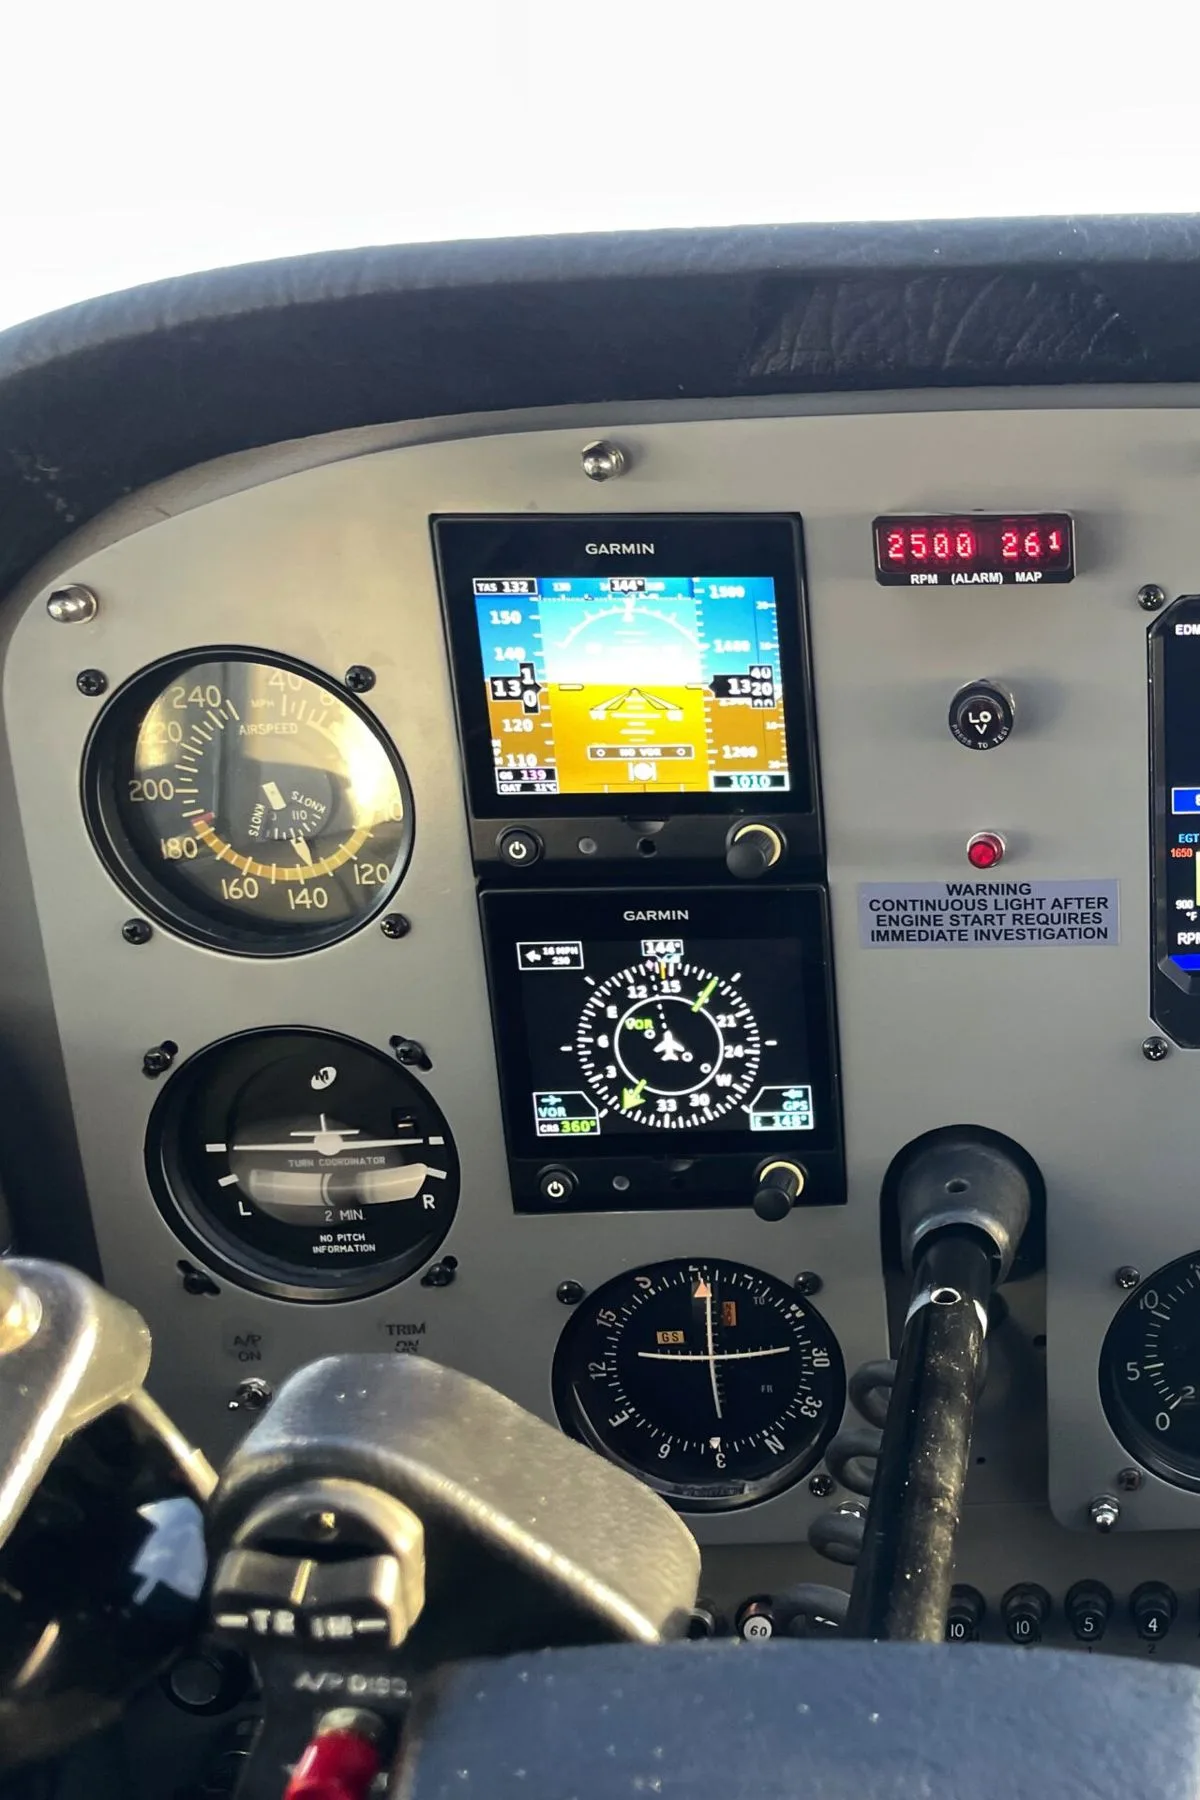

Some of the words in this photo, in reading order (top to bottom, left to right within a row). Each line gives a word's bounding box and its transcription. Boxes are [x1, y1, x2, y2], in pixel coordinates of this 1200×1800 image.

[585, 543, 654, 555] GARMIN
[888, 533, 974, 559] 2500
[911, 574, 937, 585] RPM
[951, 572, 1003, 585] (ALARM)
[1016, 572, 1042, 582] MAP
[477, 583, 497, 592] TAS
[501, 581, 529, 593] 132
[490, 611, 521, 624] 150
[171, 686, 221, 709] 240
[239, 723, 297, 735] AIRSPEED
[502, 719, 533, 732] 120
[520, 769, 546, 781] 139
[730, 776, 770, 787] 1010
[129, 779, 174, 801] 200
[1179, 834, 1199, 843] EGT
[161, 839, 197, 859] 180
[354, 863, 390, 885] 120
[222, 878, 258, 899] 160
[946, 883, 1032, 896] WARNING
[288, 888, 327, 909] 140
[869, 898, 988, 912] CONTINUOUS
[994, 898, 1045, 910] LIGHT
[1050, 897, 1108, 910] AFTER
[624, 910, 689, 921] GARMIN
[876, 914, 944, 926] ENGINE
[949, 913, 1006, 926] START
[1012, 912, 1102, 925] REQUIRES
[870, 929, 969, 942] IMMEDIATE
[974, 927, 1108, 941] INVESTIGATION
[538, 1107, 566, 1117] VOR
[783, 1101, 807, 1111] GPS
[288, 1159, 315, 1167] TURN
[319, 1156, 385, 1166] COORDINATOR
[320, 1234, 332, 1242] NO
[337, 1233, 365, 1242] PITCH
[313, 1243, 375, 1253] INFORMATION
[1140, 1290, 1158, 1309] 10
[386, 1323, 425, 1335] TRIM
